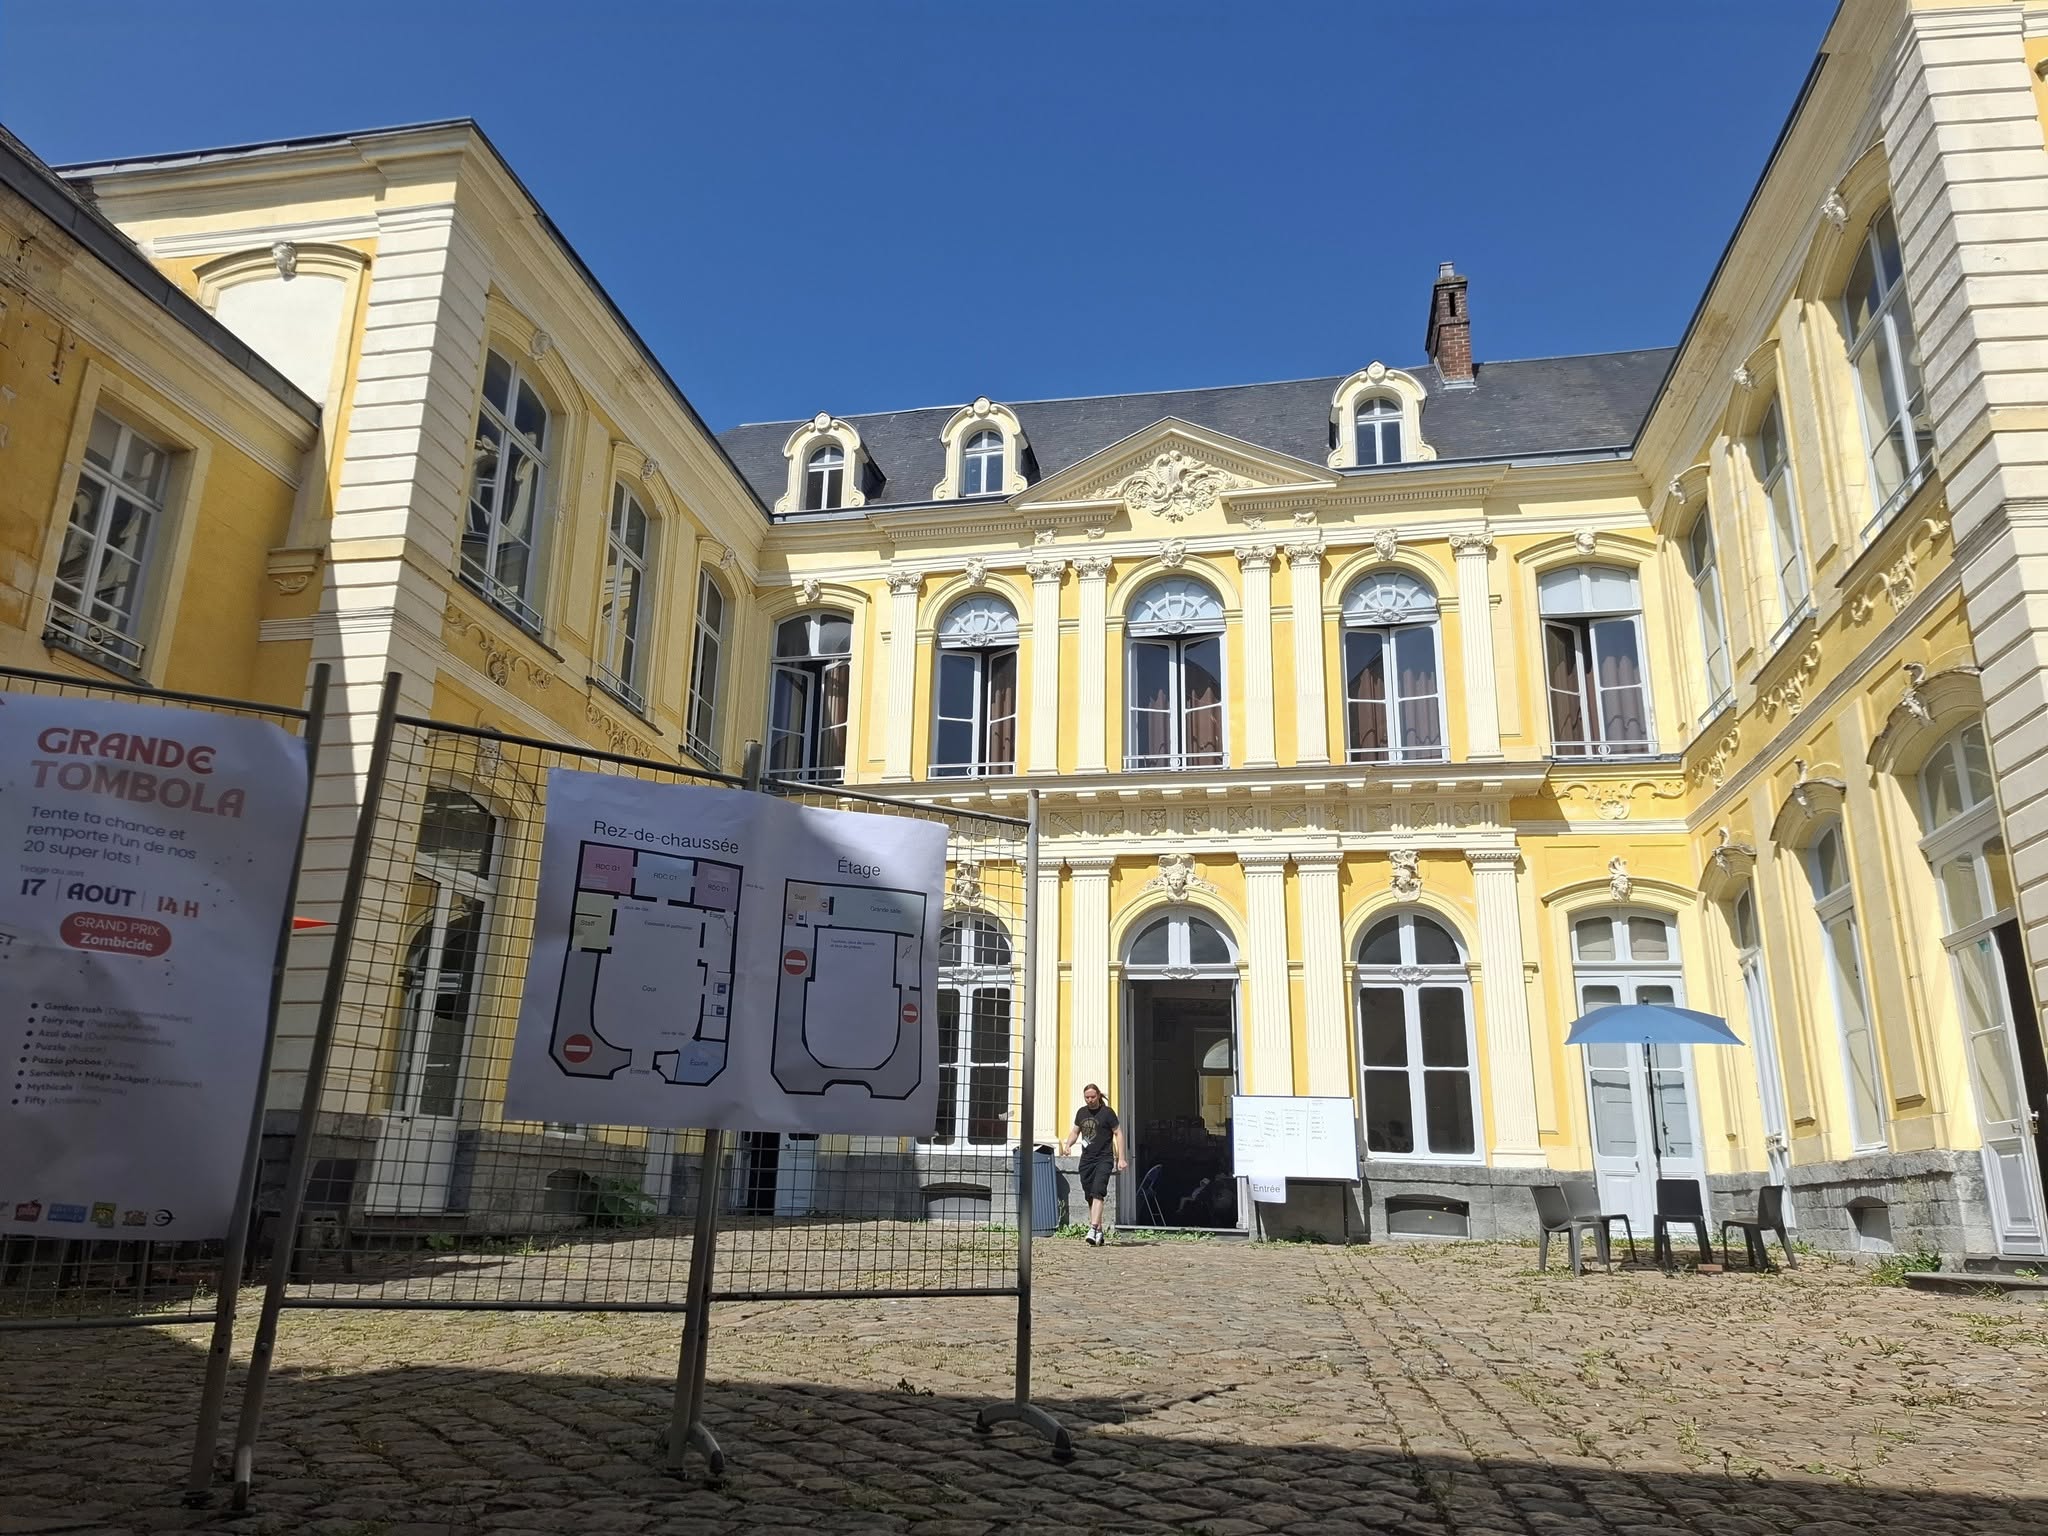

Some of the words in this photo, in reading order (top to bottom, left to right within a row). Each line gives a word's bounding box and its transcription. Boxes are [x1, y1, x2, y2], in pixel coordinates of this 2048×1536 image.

[37, 727, 216, 774] GRANDE
[31, 760, 245, 818] TOMBOLA
[31, 806, 79, 821] Tente
[84, 811, 101, 824] ta
[105, 813, 165, 837] chance
[169, 829, 186, 841] et
[27, 824, 109, 845] remporte
[113, 833, 140, 849] l'un
[144, 840, 164, 855] de
[167, 846, 197, 860] nos
[593, 820, 739, 854] Rez-de-chaussée
[23, 840, 45, 853] 20
[49, 843, 99, 860] super
[103, 848, 131, 865] lots
[135, 855, 140, 866] !
[20, 865, 49, 876] Tirage
[595, 862, 610, 871] RDC
[837, 856, 881, 878] Étage
[653, 872, 668, 880] RDC
[707, 883, 720, 892] RDC
[20, 879, 46, 896] 17
[156, 896, 178, 915] 14
[183, 901, 200, 918] H
[73, 916, 127, 933] GRAND
[130, 922, 160, 937] PRIX
[580, 919, 595, 927] Staff
[80, 933, 153, 951] Zombicide
[44, 1002, 80, 1013] Garden
[82, 1005, 103, 1015] rush
[41, 1016, 64, 1027] Fairy
[35, 1042, 66, 1052] Puzzle
[32, 1055, 63, 1065] Puzzle
[29, 1069, 76, 1078] Sandwich
[113, 1073, 150, 1085] Jackpot
[24, 1096, 46, 1106] Fifty
[1253, 1184, 1281, 1194] Entrée
